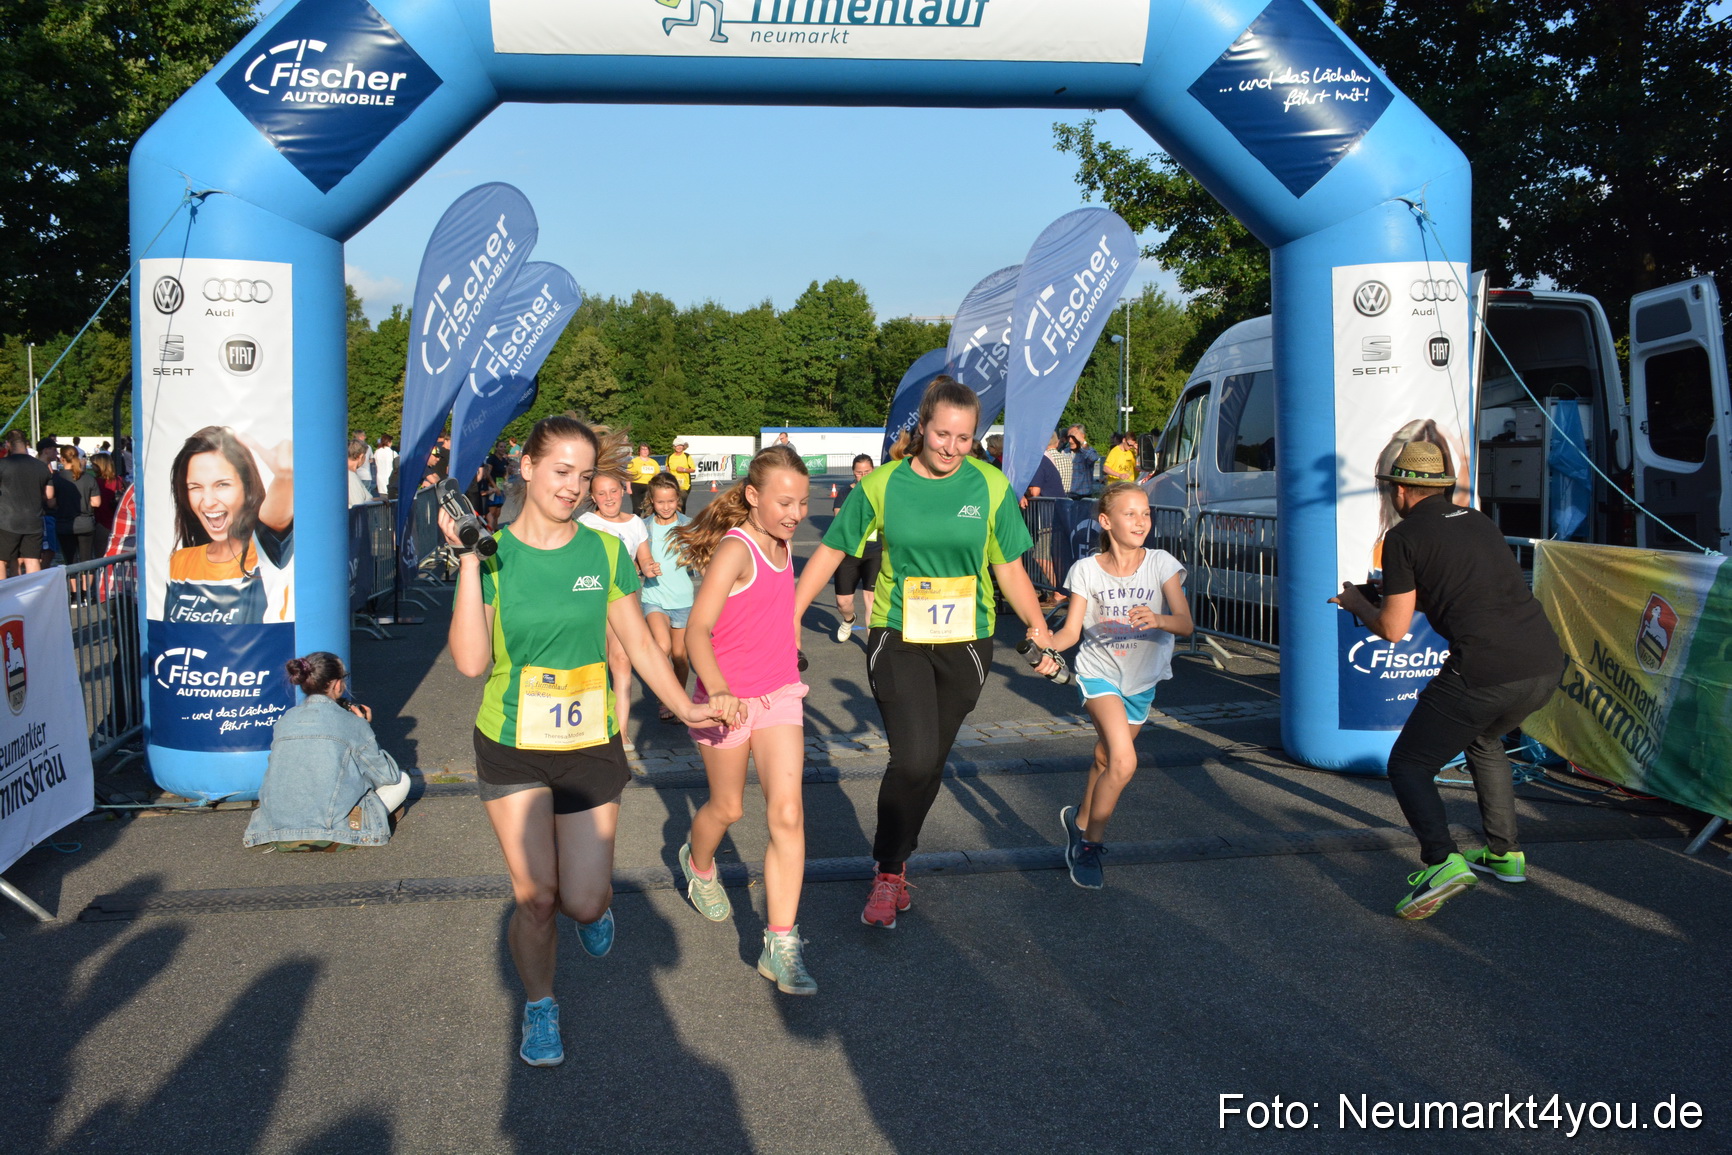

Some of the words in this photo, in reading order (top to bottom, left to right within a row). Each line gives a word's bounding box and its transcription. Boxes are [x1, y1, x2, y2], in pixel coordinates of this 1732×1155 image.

[750, 27, 850, 44] neumarkt
[270, 62, 407, 91] Fischer
[1239, 72, 1274, 91] und
[1279, 67, 1309, 85] das
[281, 91, 395, 106] AUTOMOBILE
[1283, 88, 1331, 112] fährt
[1335, 88, 1370, 102] mit!
[436, 213, 509, 353] Fischer
[456, 238, 516, 350] AUTOMOBILE
[1041, 234, 1113, 356] Fischer
[205, 308, 235, 317] Audi
[1066, 256, 1120, 354] AUTOMOBILE
[1411, 308, 1435, 316] Audi
[485, 283, 554, 381] Fischer
[508, 301, 562, 380] AUTOMOBILE
[229, 346, 254, 365] FIAT
[1431, 343, 1448, 360] FIAT
[153, 367, 194, 376] SEAT
[1352, 366, 1402, 376] SEAT
[958, 505, 981, 517] AOK
[572, 575, 602, 589] AOK
[176, 605, 239, 625] Fischer
[927, 604, 956, 625] 17
[1370, 646, 1452, 668] Fische
[1640, 650, 1656, 669] 1628
[168, 664, 270, 686] Fischer
[1380, 668, 1441, 679] AUTOMOB
[176, 687, 261, 698] AUTOMOBILE
[1397, 688, 1418, 701] und
[192, 709, 213, 721] und
[216, 706, 237, 719] das
[549, 700, 583, 728] 16
[219, 719, 251, 735] fährt
[0, 722, 46, 772] eumarkter
[0, 749, 67, 820] mmsbräu
